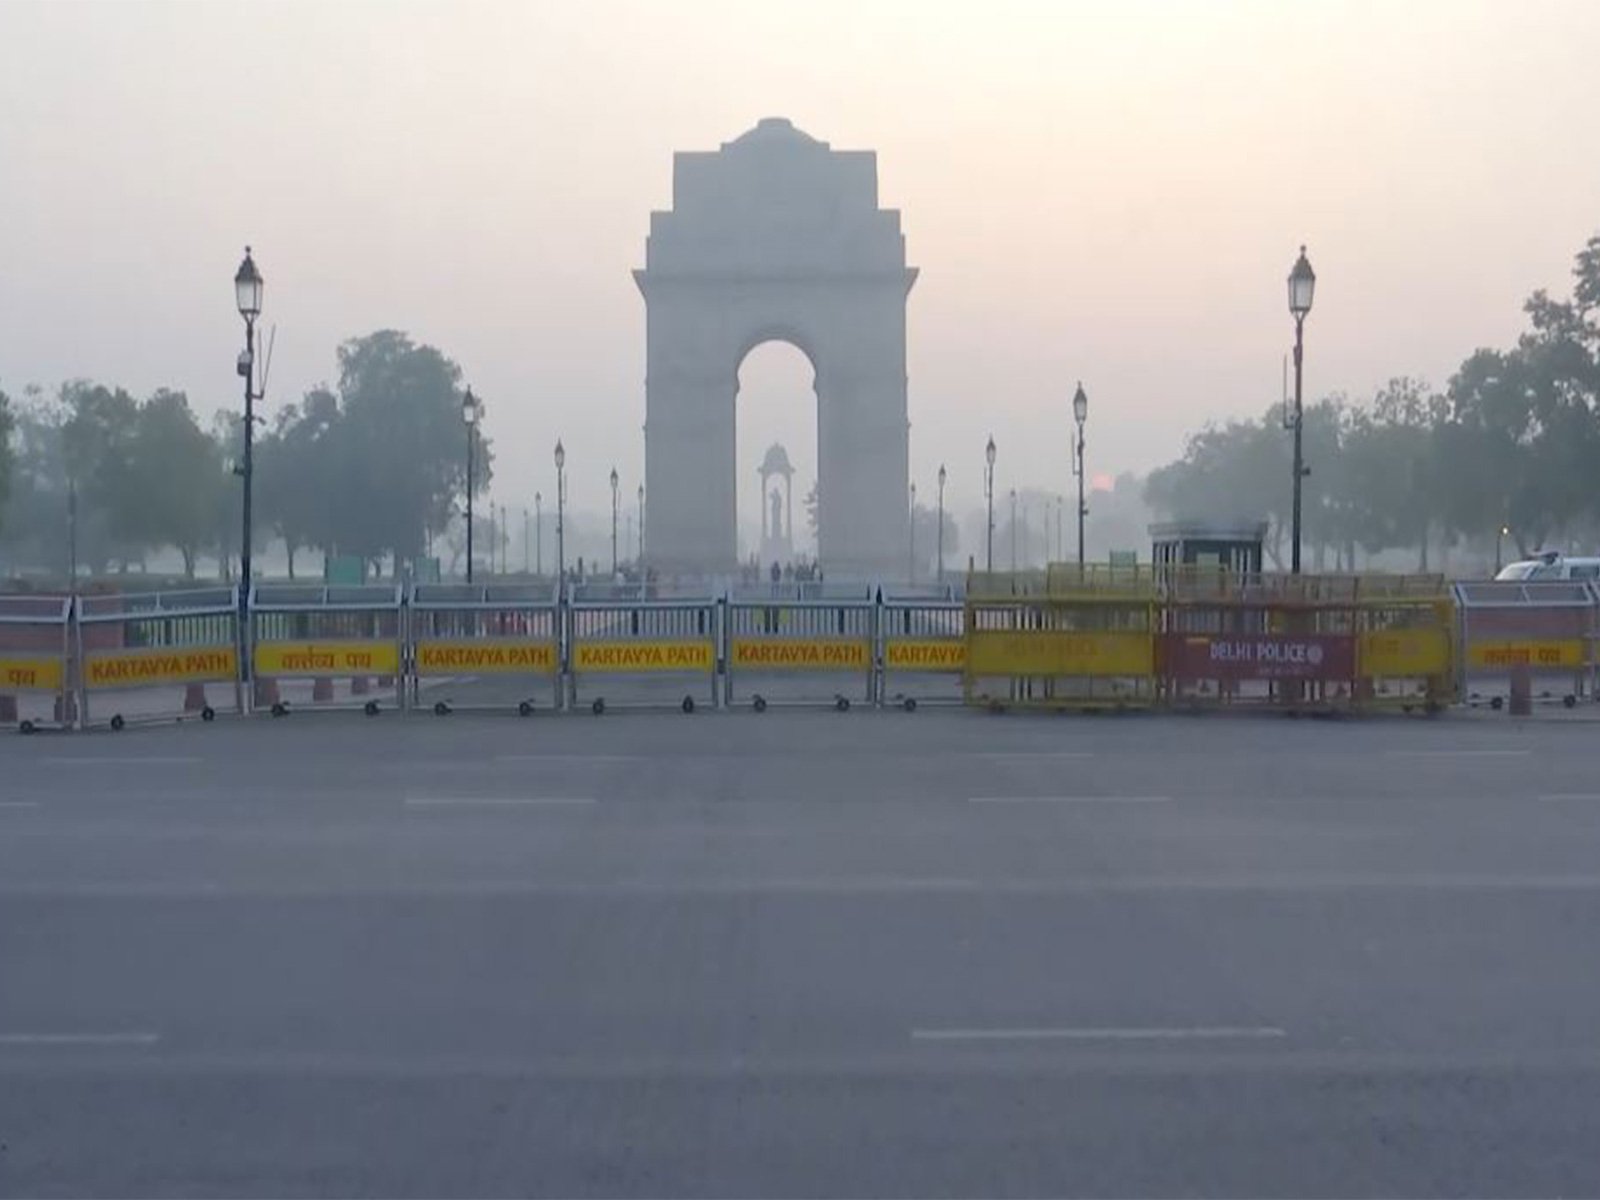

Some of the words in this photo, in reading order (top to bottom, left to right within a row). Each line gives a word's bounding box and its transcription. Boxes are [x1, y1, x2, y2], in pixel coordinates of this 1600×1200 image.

[346, 653, 371, 669] पथ
[423, 645, 504, 666] KARTAVYA
[509, 645, 549, 665] PATH
[580, 646, 662, 665] KARTAVYA
[667, 645, 707, 664] PATH
[738, 645, 820, 663] KARTAVYA
[823, 645, 862, 663] PATH
[1210, 641, 1251, 661] DELHI
[1257, 642, 1306, 663] POLICE
[91, 656, 184, 681] KARTAVYA
[186, 654, 229, 673] PATH
